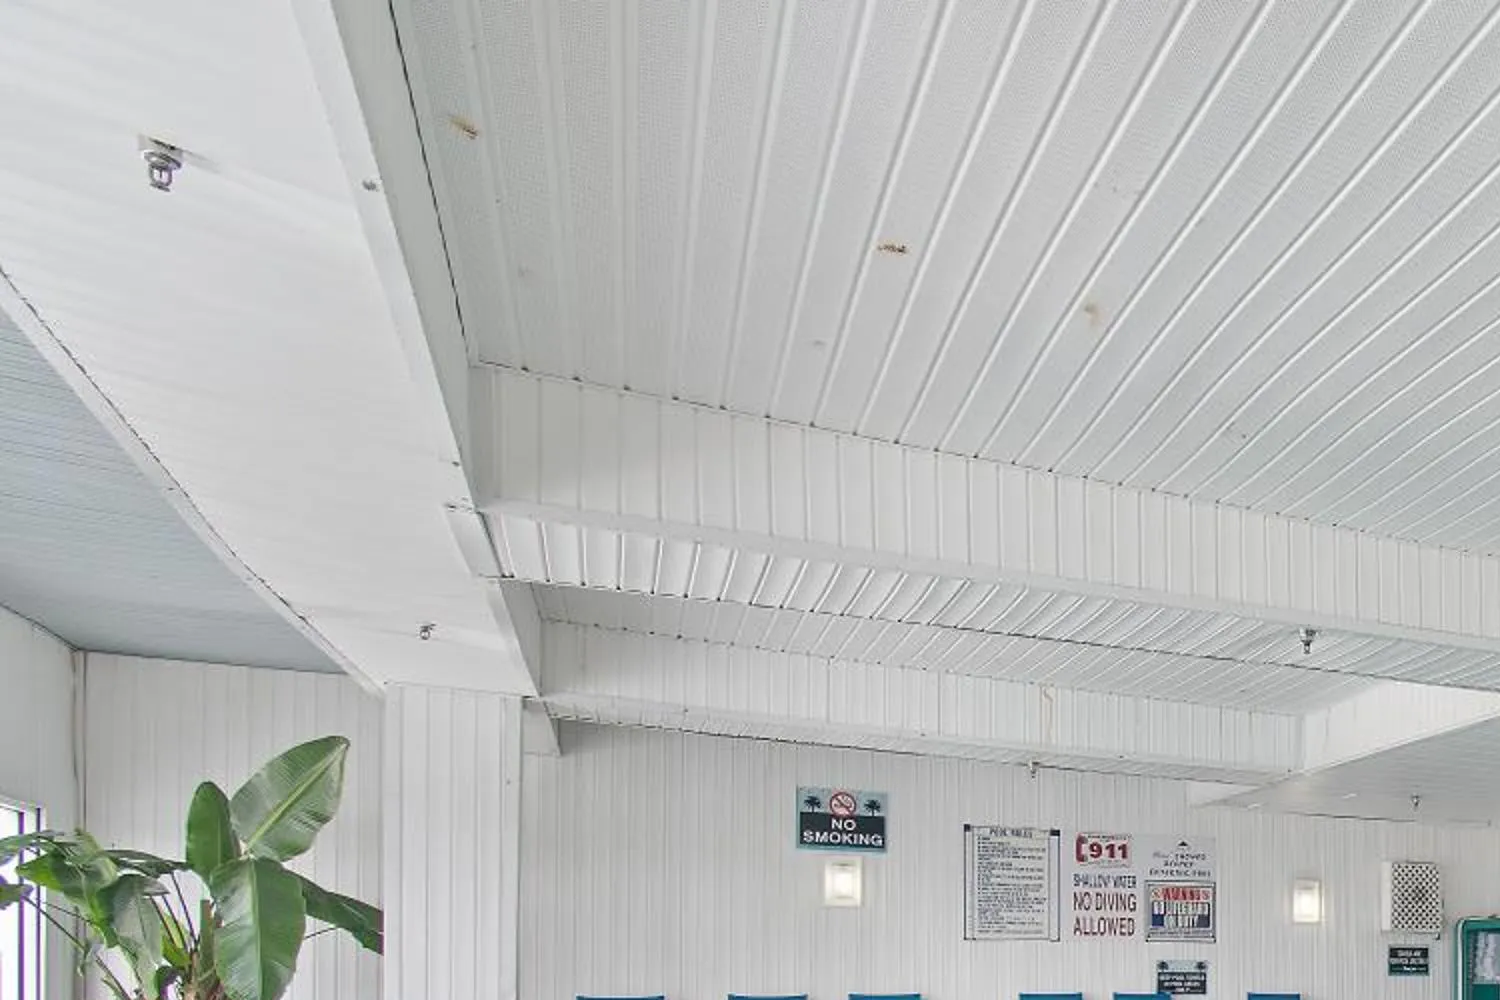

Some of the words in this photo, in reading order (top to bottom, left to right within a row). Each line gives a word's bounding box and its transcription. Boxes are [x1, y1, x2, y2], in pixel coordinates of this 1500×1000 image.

[831, 818, 857, 831] NO
[803, 830, 883, 846] SMOKING
[1089, 841, 1129, 859] 911
[1073, 892, 1092, 911] NO
[1095, 892, 1137, 913] DIVING
[1073, 917, 1135, 936] ALLOWED
